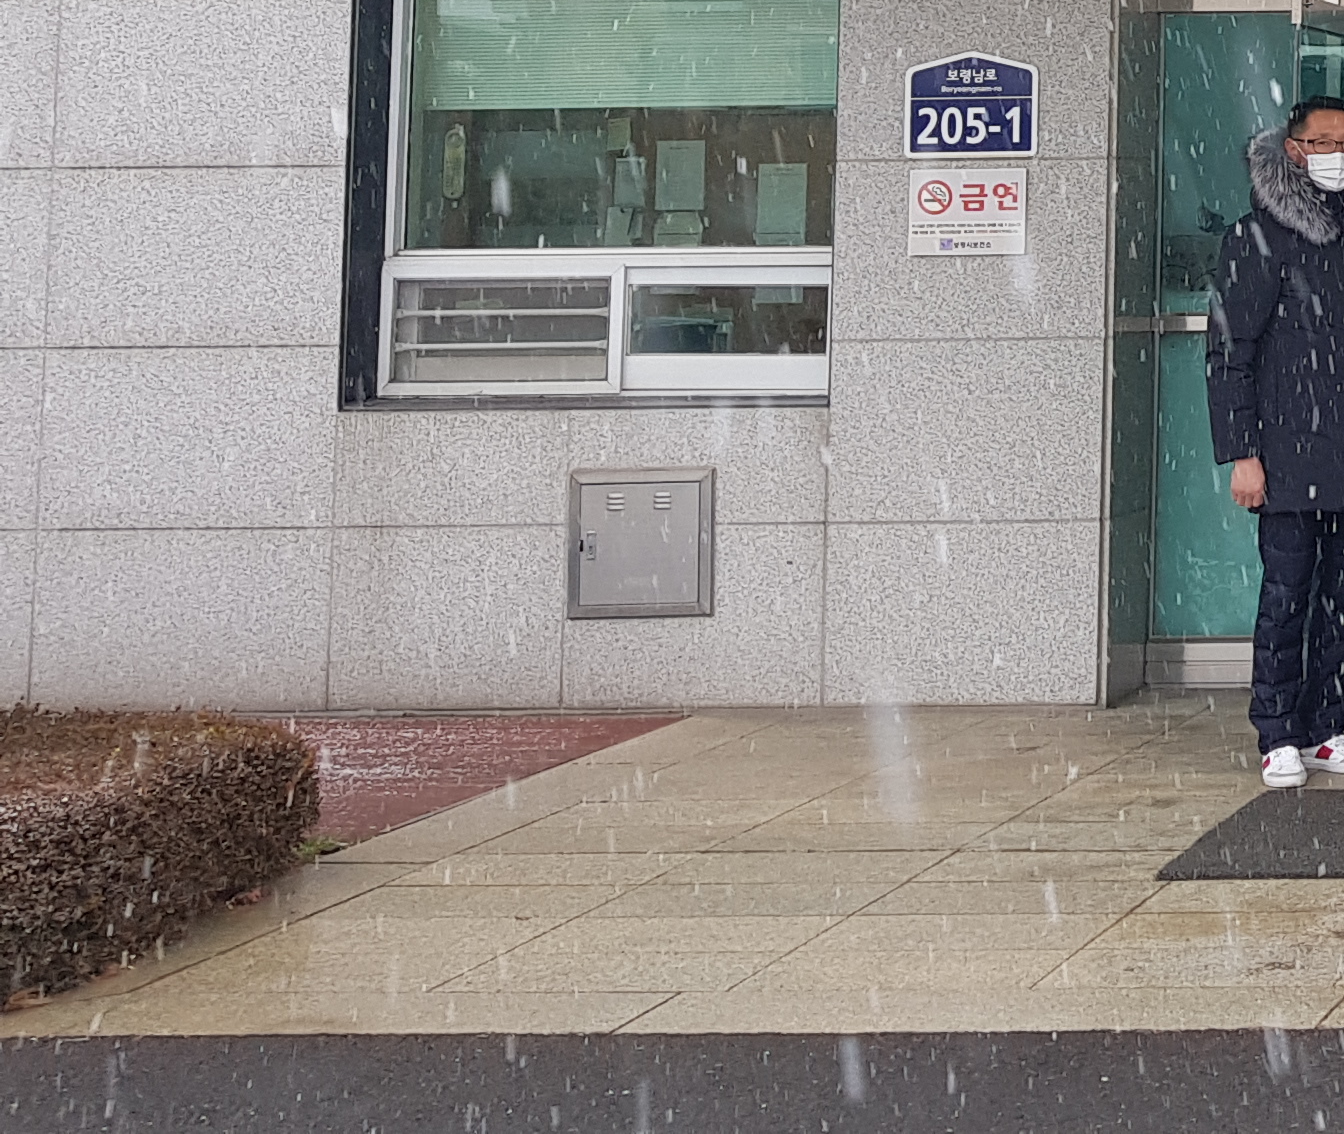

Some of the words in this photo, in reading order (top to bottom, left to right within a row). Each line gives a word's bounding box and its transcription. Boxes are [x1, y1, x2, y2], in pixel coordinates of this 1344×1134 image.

[946, 68, 997, 83] 보령남로
[917, 107, 1020, 144] 205-1
[960, 182, 1018, 211] 금연
